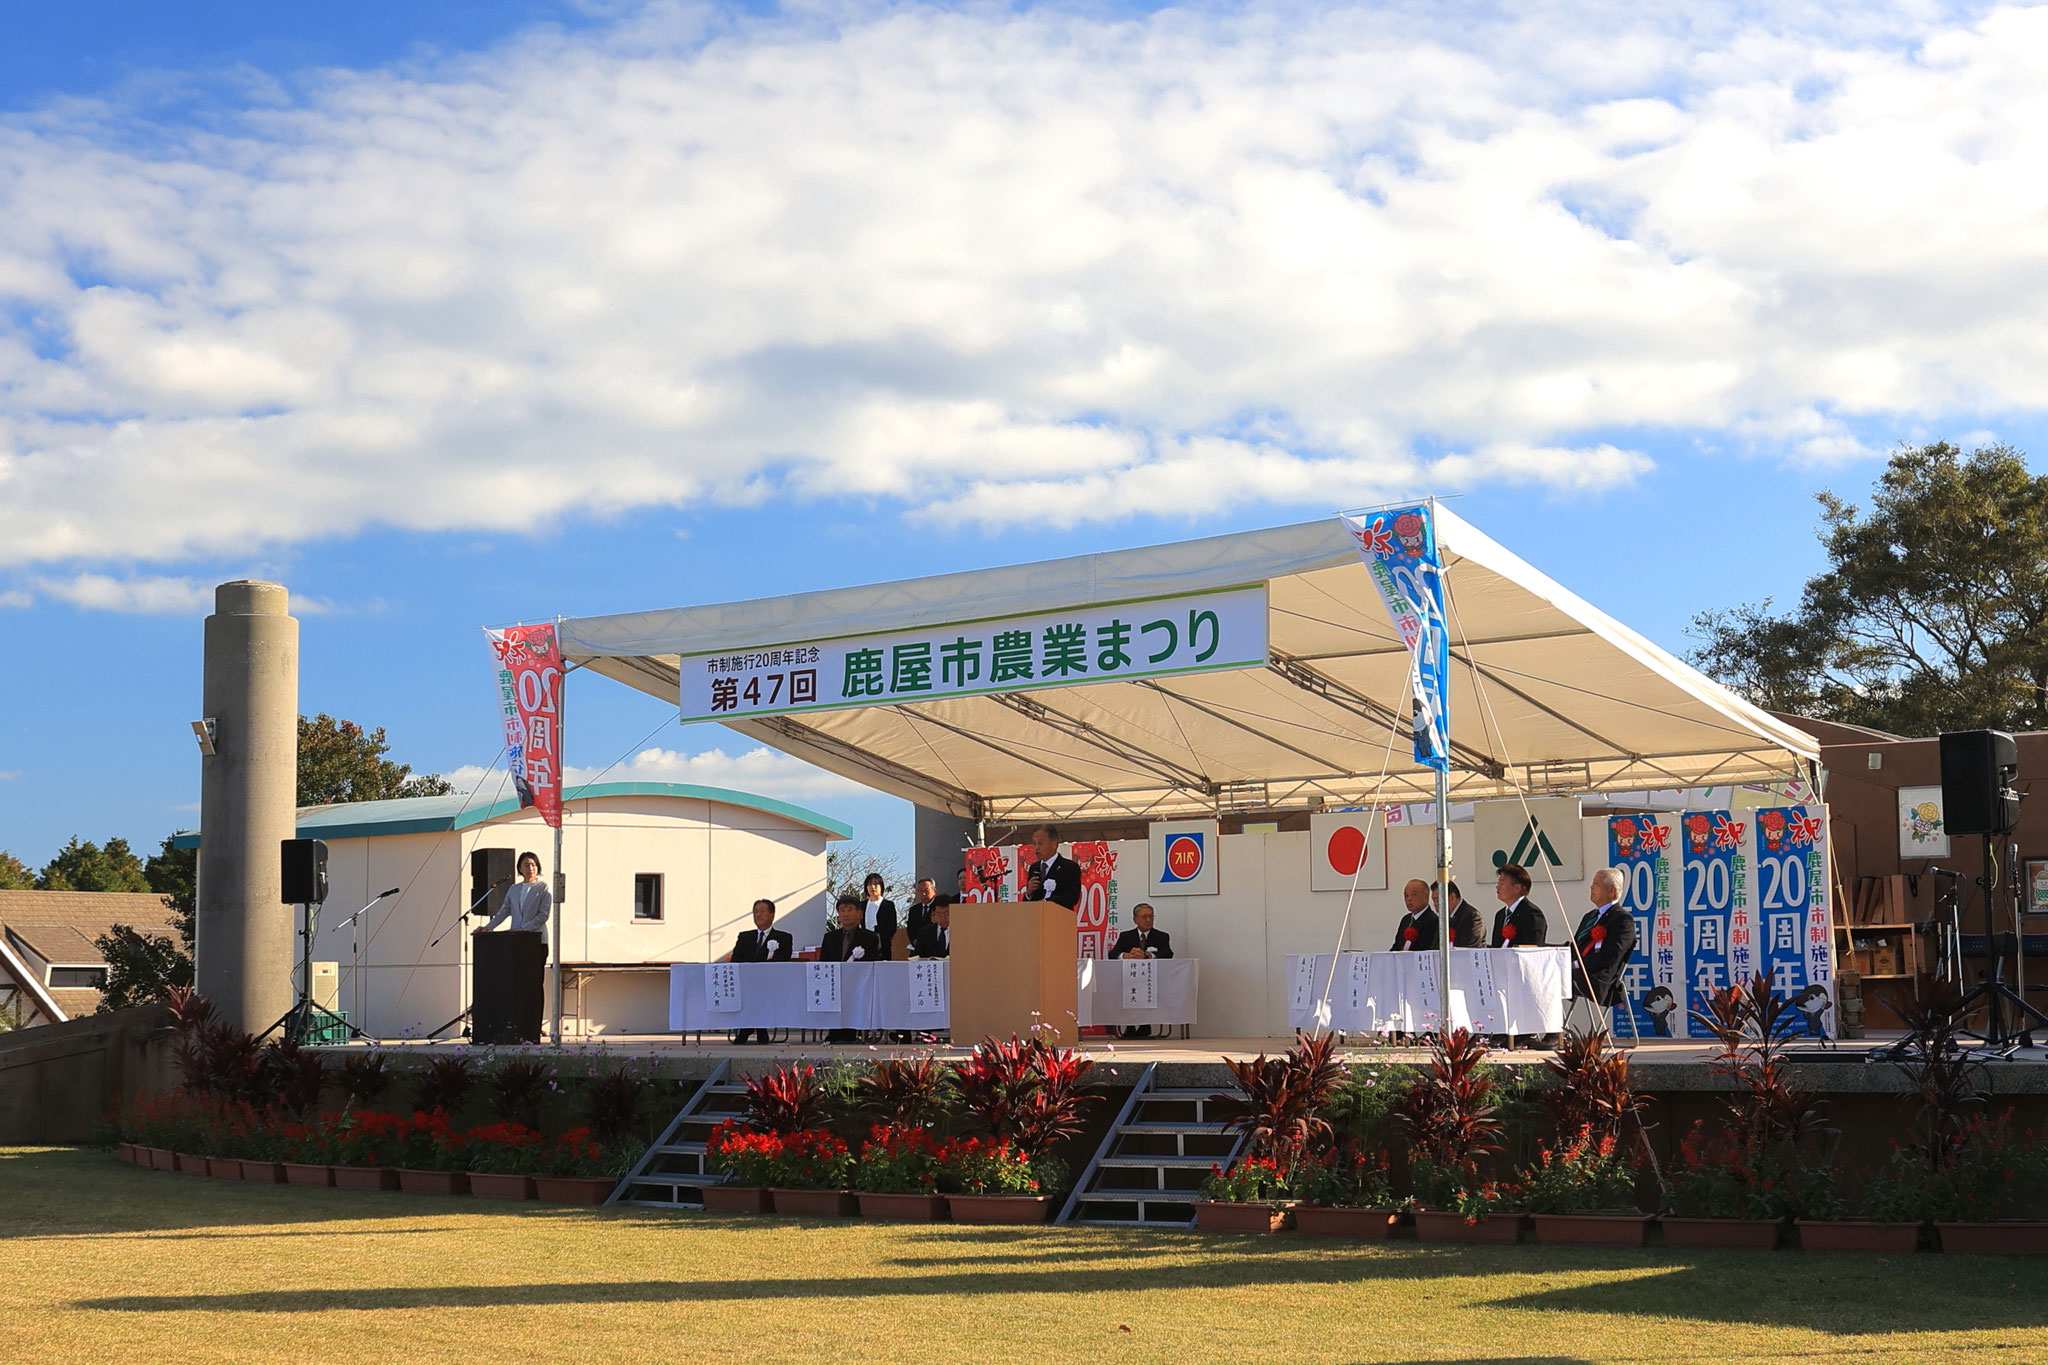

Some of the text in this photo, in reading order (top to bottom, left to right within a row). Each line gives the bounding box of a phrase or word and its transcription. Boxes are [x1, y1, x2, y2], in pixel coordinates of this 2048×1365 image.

[706, 646, 821, 674] 市制施行20周年記念
[841, 608, 1222, 699] 鹿屋市農業まつり
[710, 668, 818, 712] 第47回
[1639, 818, 1672, 855] 祝
[1713, 814, 1748, 852] 祝
[1788, 810, 1824, 850] 祝
[1095, 845, 1119, 877] 祝
[1654, 857, 1674, 984] 鹿屋市市制施行
[1730, 854, 1750, 983] 鹿屋市市制施行
[1762, 854, 1806, 1000] 20周年
[1806, 850, 1829, 983] 鹿屋市市制施行
